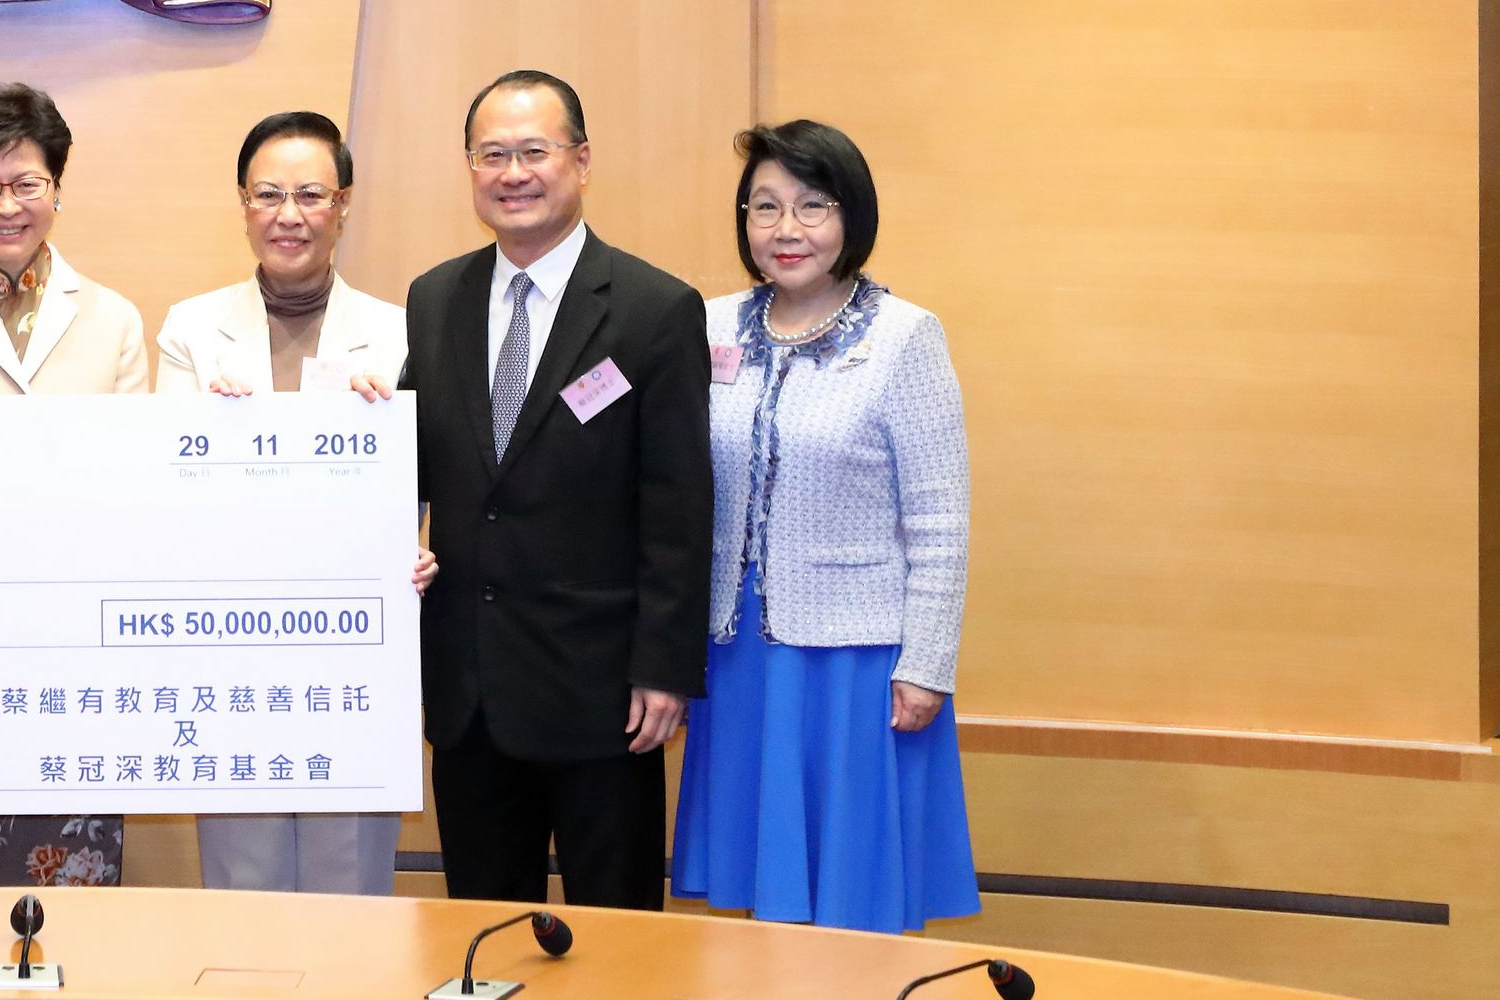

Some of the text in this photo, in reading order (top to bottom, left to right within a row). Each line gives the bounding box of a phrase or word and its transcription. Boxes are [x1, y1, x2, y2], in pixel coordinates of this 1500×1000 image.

[179, 433, 378, 457] 29 11 2018
[179, 468, 198, 479] Day
[245, 467, 278, 478] Month
[328, 466, 351, 477] Year
[118, 610, 370, 640] HK$ 50,000,000.00
[1, 684, 371, 715] 蔡繼有教育及慈善信託
[172, 720, 200, 748] 及
[39, 753, 333, 783] 蔡冠深教育基金會
